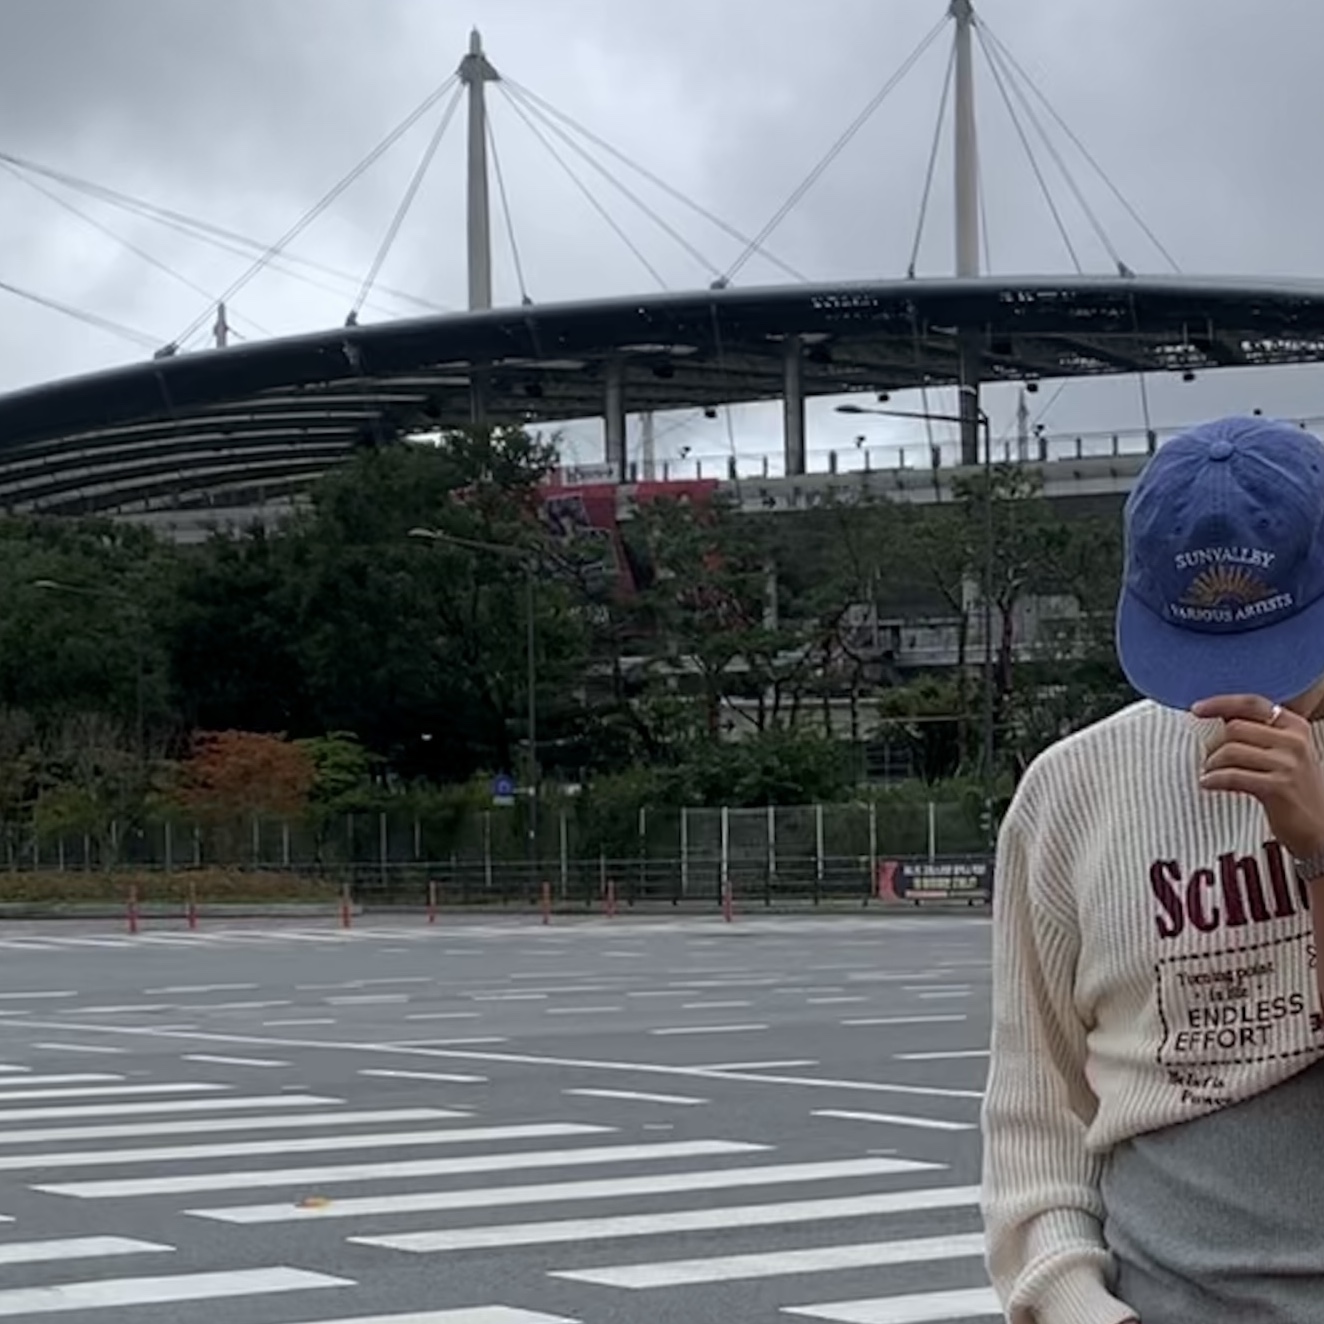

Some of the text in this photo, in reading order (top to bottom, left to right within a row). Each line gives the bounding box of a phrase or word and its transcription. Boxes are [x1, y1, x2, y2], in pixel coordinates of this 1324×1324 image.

[1174, 546, 1276, 569] SUNVALLEY
[1170, 593, 1293, 622] VARIOUS ARTISTS
[1188, 993, 1304, 1028] ENDLESS
[1175, 1024, 1273, 1051] EFFORT
